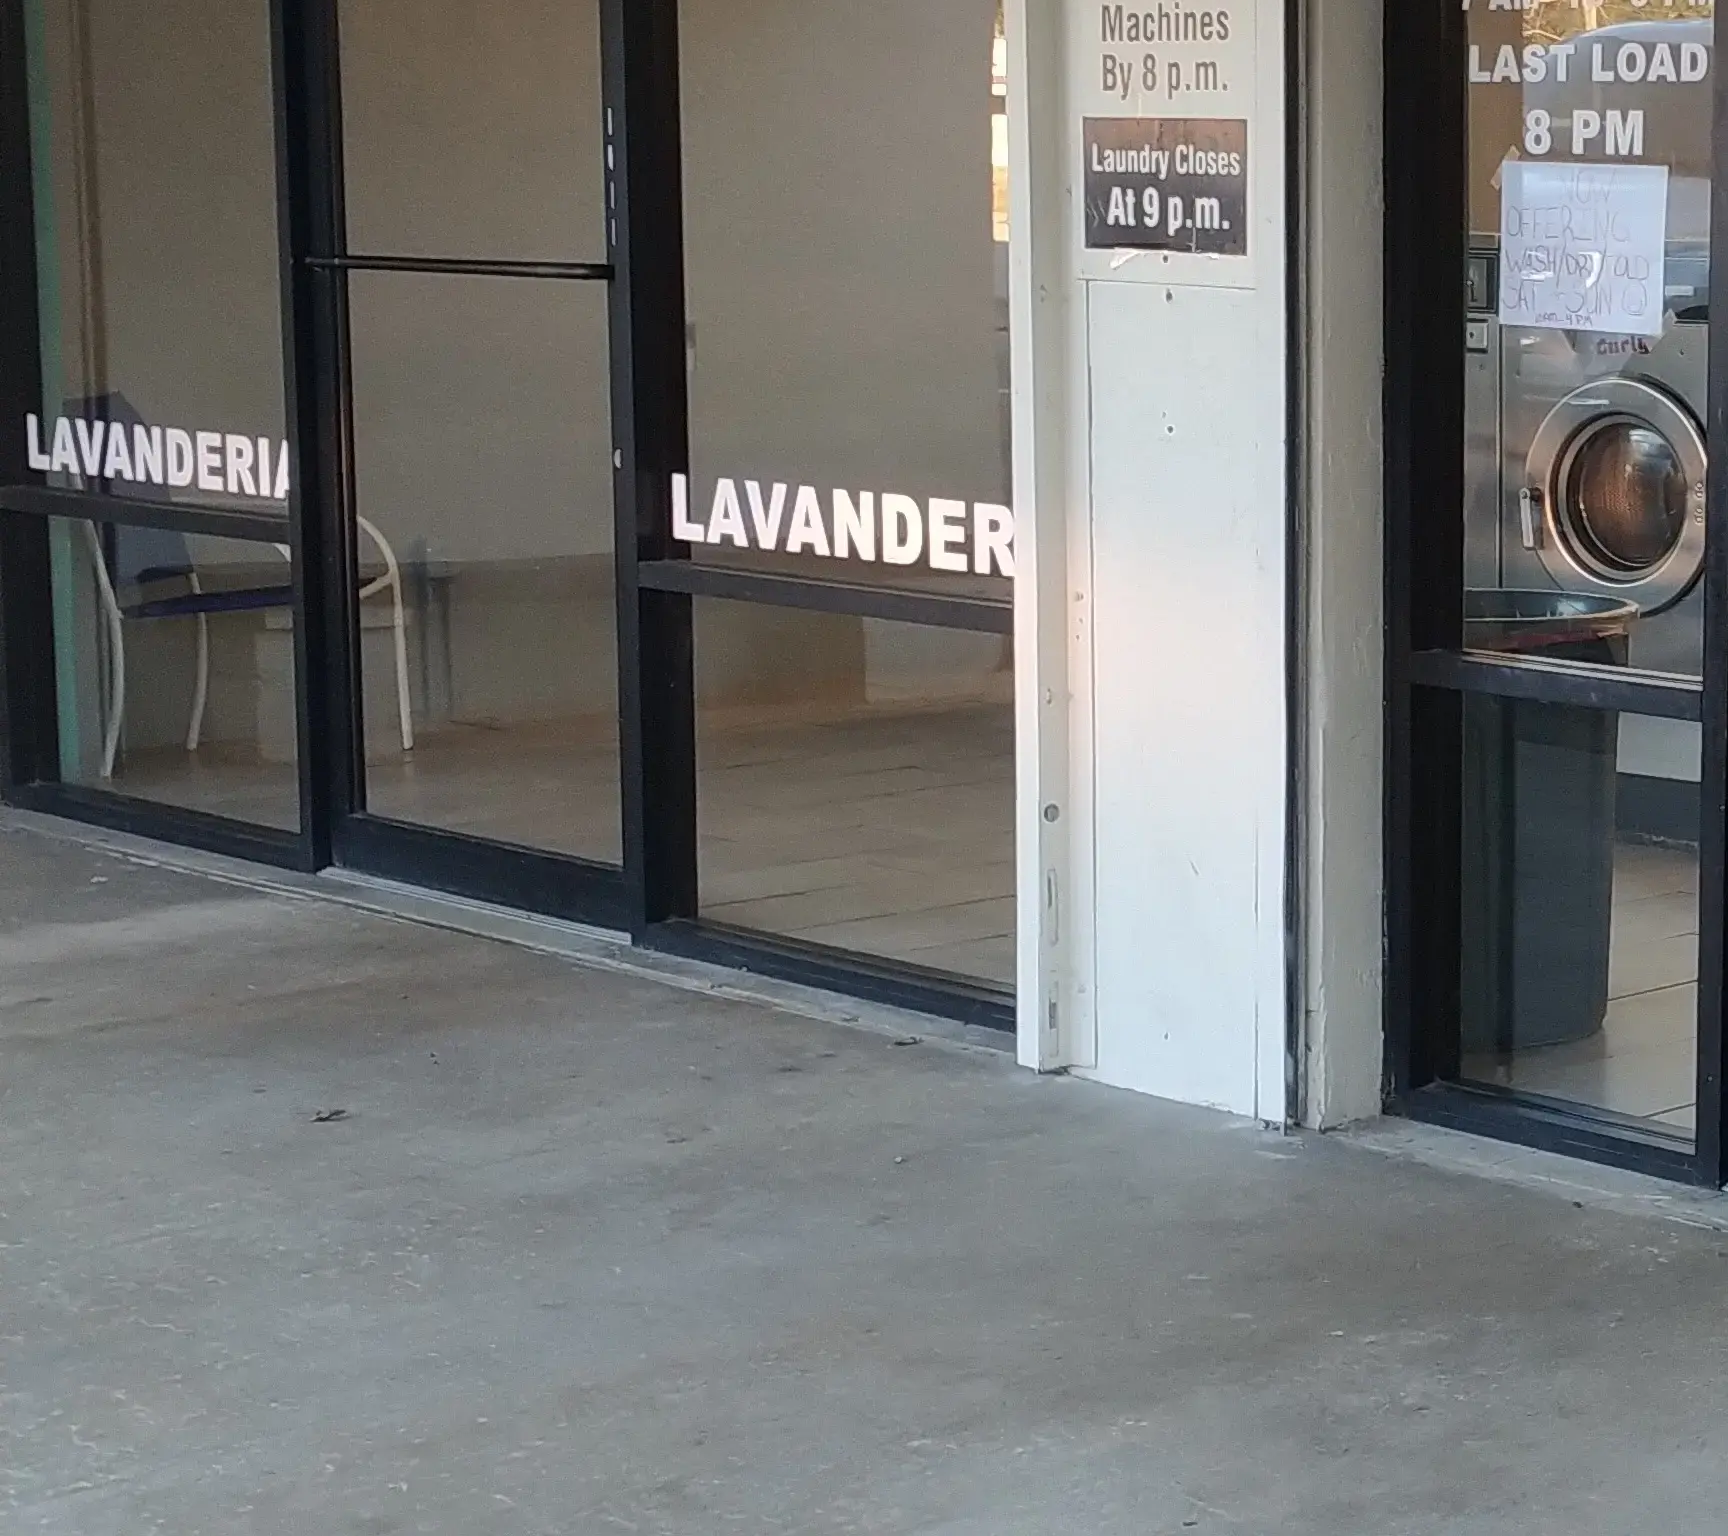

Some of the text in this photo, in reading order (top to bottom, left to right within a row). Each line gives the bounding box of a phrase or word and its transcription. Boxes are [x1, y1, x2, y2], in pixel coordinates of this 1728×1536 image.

[1101, 1, 1230, 42] Machines
[1102, 53, 1228, 101] By 8 p.m.
[1468, 42, 1709, 84] LAST LOAD
[1524, 109, 1645, 157] 8 PM
[1091, 142, 1242, 181] Laundry Closes
[1107, 186, 1230, 237] At 9 p.m.
[1507, 205, 1632, 243] OFFERING
